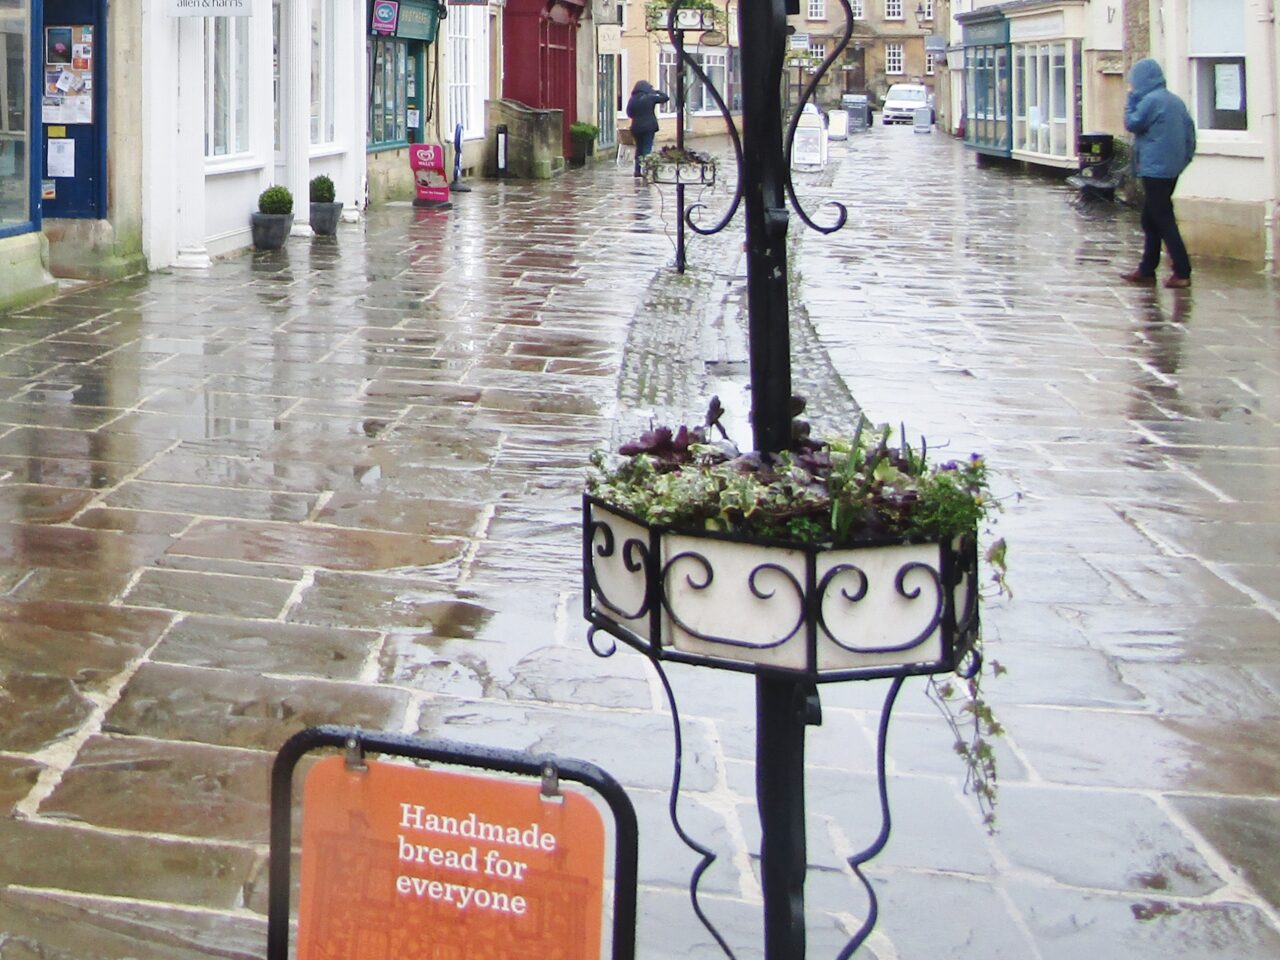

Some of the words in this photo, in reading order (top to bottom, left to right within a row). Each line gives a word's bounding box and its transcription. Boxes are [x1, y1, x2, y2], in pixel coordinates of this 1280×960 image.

[399, 803, 556, 852] Handmade
[398, 835, 478, 872] bread
[484, 850, 528, 880] for
[396, 874, 527, 915] everyone
